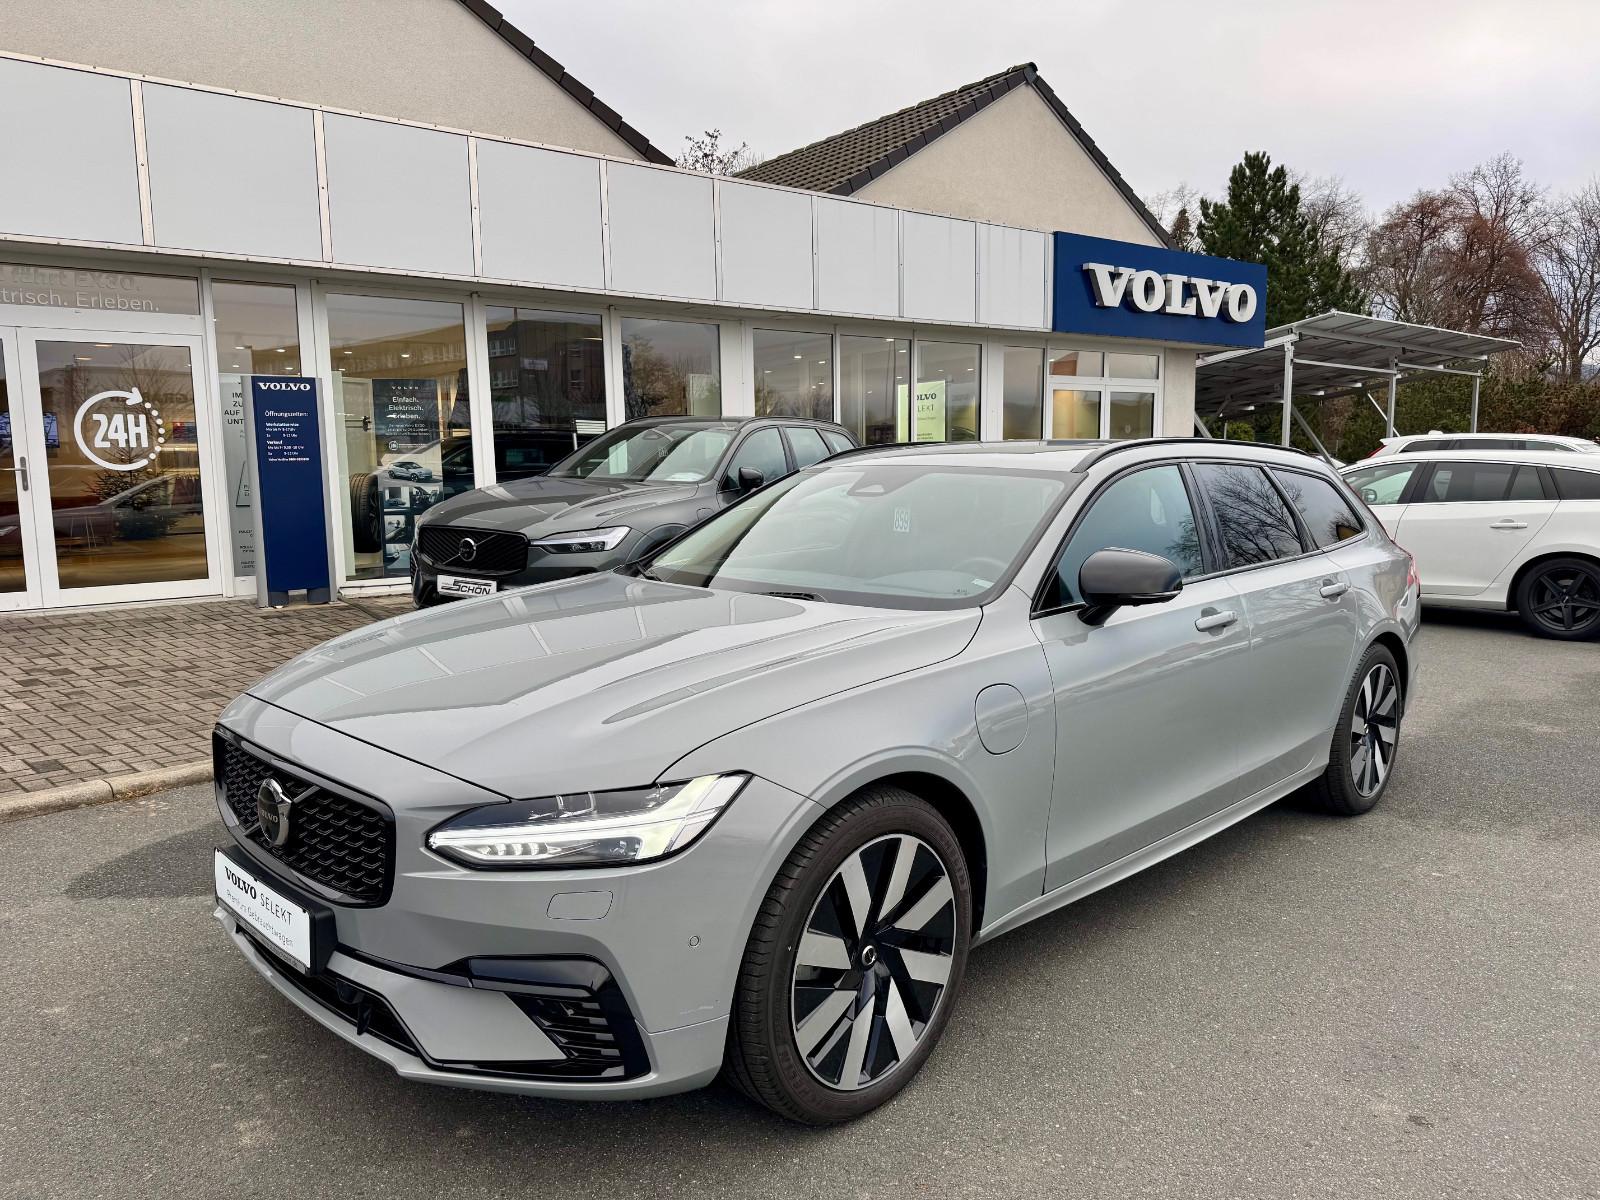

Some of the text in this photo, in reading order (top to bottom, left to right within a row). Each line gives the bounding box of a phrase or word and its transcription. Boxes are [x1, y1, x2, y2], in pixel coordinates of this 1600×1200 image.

[0, 287, 160, 312] trisch. Erleben.
[1082, 262, 1257, 323] VOLVO
[257, 381, 311, 391] VOLVO
[92, 413, 149, 448] 24H
[441, 578, 492, 595] SCHÖN
[224, 865, 257, 900] VOLVO
[259, 893, 293, 926] SELEKT
